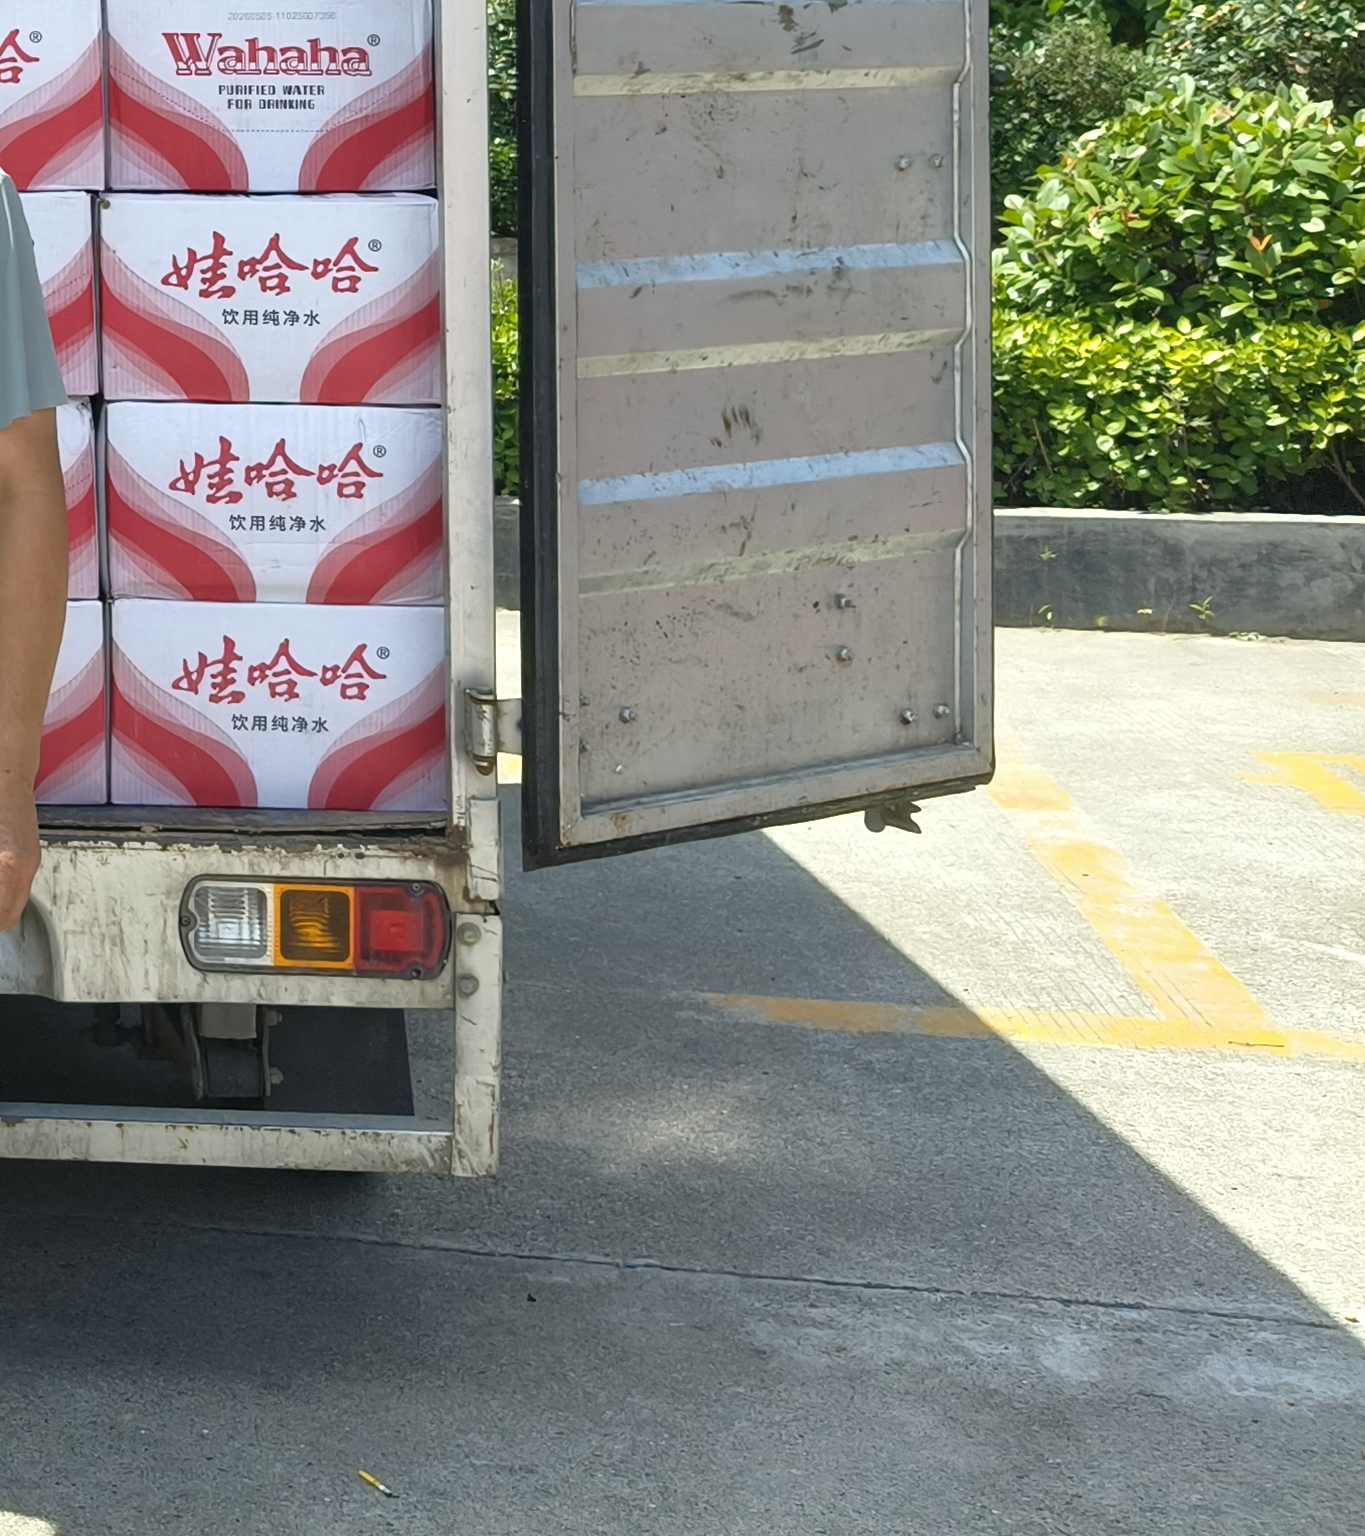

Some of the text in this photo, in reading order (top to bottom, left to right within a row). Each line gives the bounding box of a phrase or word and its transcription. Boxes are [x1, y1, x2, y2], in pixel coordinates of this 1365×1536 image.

[161, 32, 372, 76] Wahaha
[218, 84, 325, 96] PURIFIED WATER
[227, 99, 316, 110] FOR DRINKING
[161, 230, 378, 299] 娃哈哈
[221, 308, 321, 327] 饮用纯净水
[168, 436, 383, 505] 娃哈哈
[229, 514, 327, 532] 饮用纯净水
[171, 635, 387, 705] 娃哈哈
[231, 713, 329, 733] 饮用纯净水
